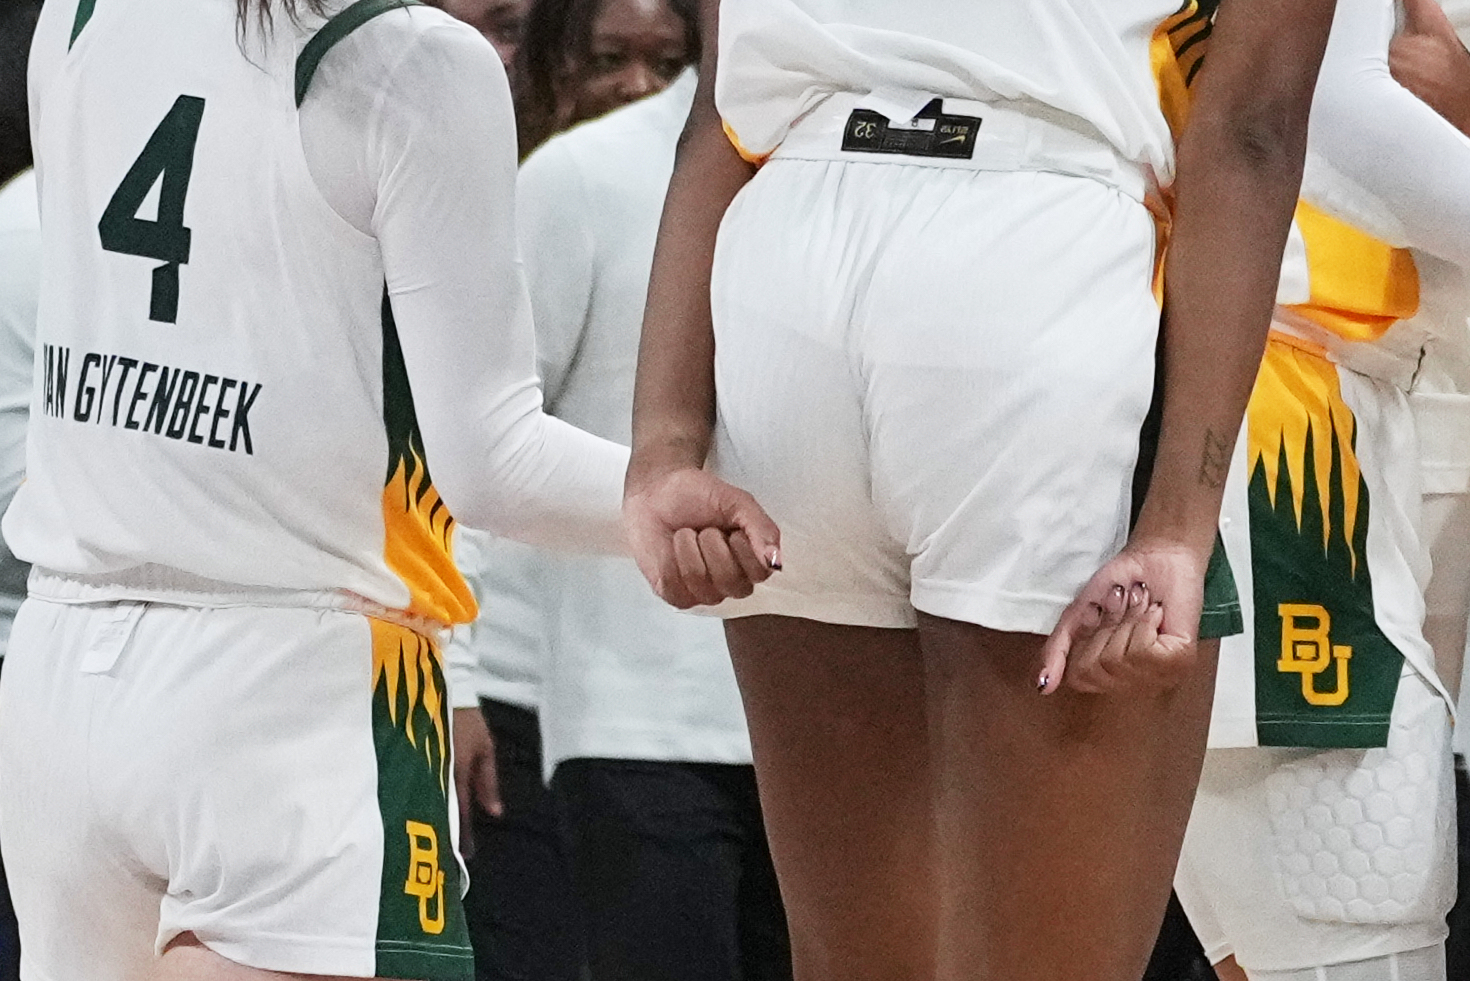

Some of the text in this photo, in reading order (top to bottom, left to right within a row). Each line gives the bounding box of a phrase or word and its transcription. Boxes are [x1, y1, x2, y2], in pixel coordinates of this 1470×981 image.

[97, 93, 206, 326] 4
[73, 352, 263, 455] GYTENBEEK
[1277, 603, 1352, 706] BU
[404, 819, 446, 934] BU
